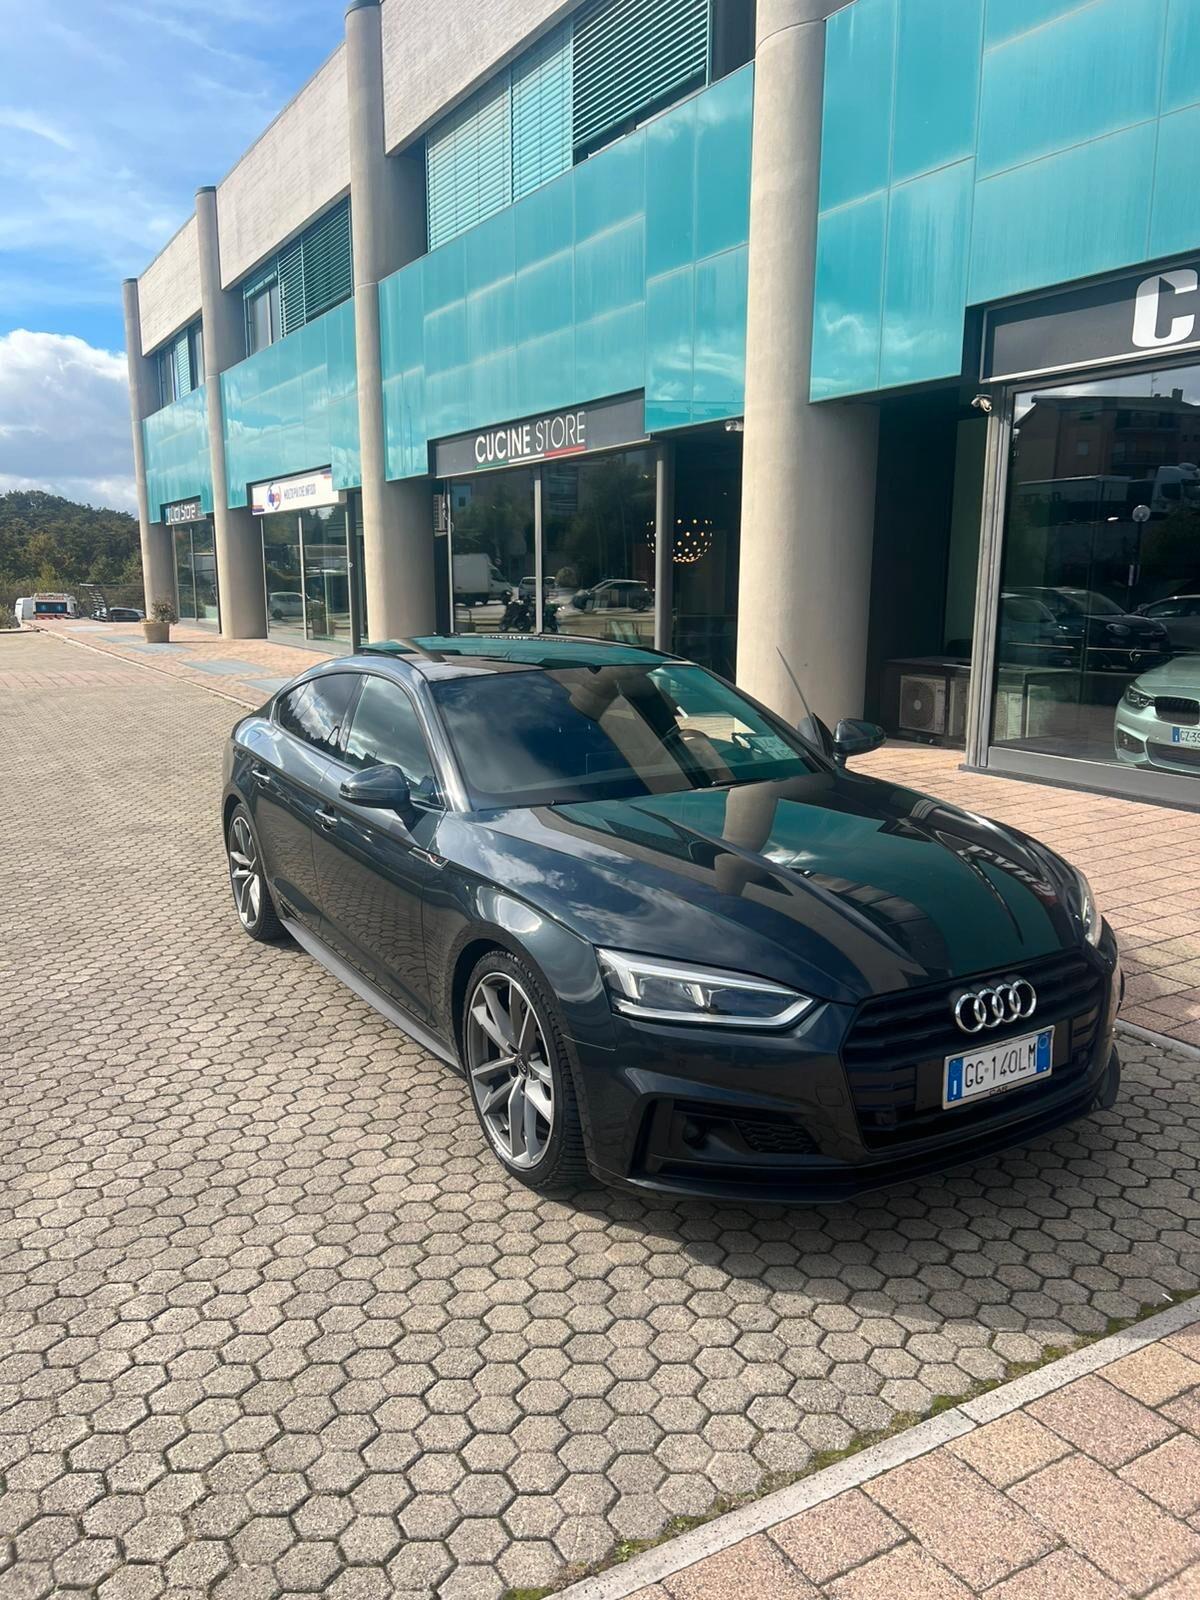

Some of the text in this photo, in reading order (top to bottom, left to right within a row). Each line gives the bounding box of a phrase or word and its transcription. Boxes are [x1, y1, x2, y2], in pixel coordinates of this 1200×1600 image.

[1132, 268, 1199, 347] C
[474, 411, 586, 463] CUCINE STORE
